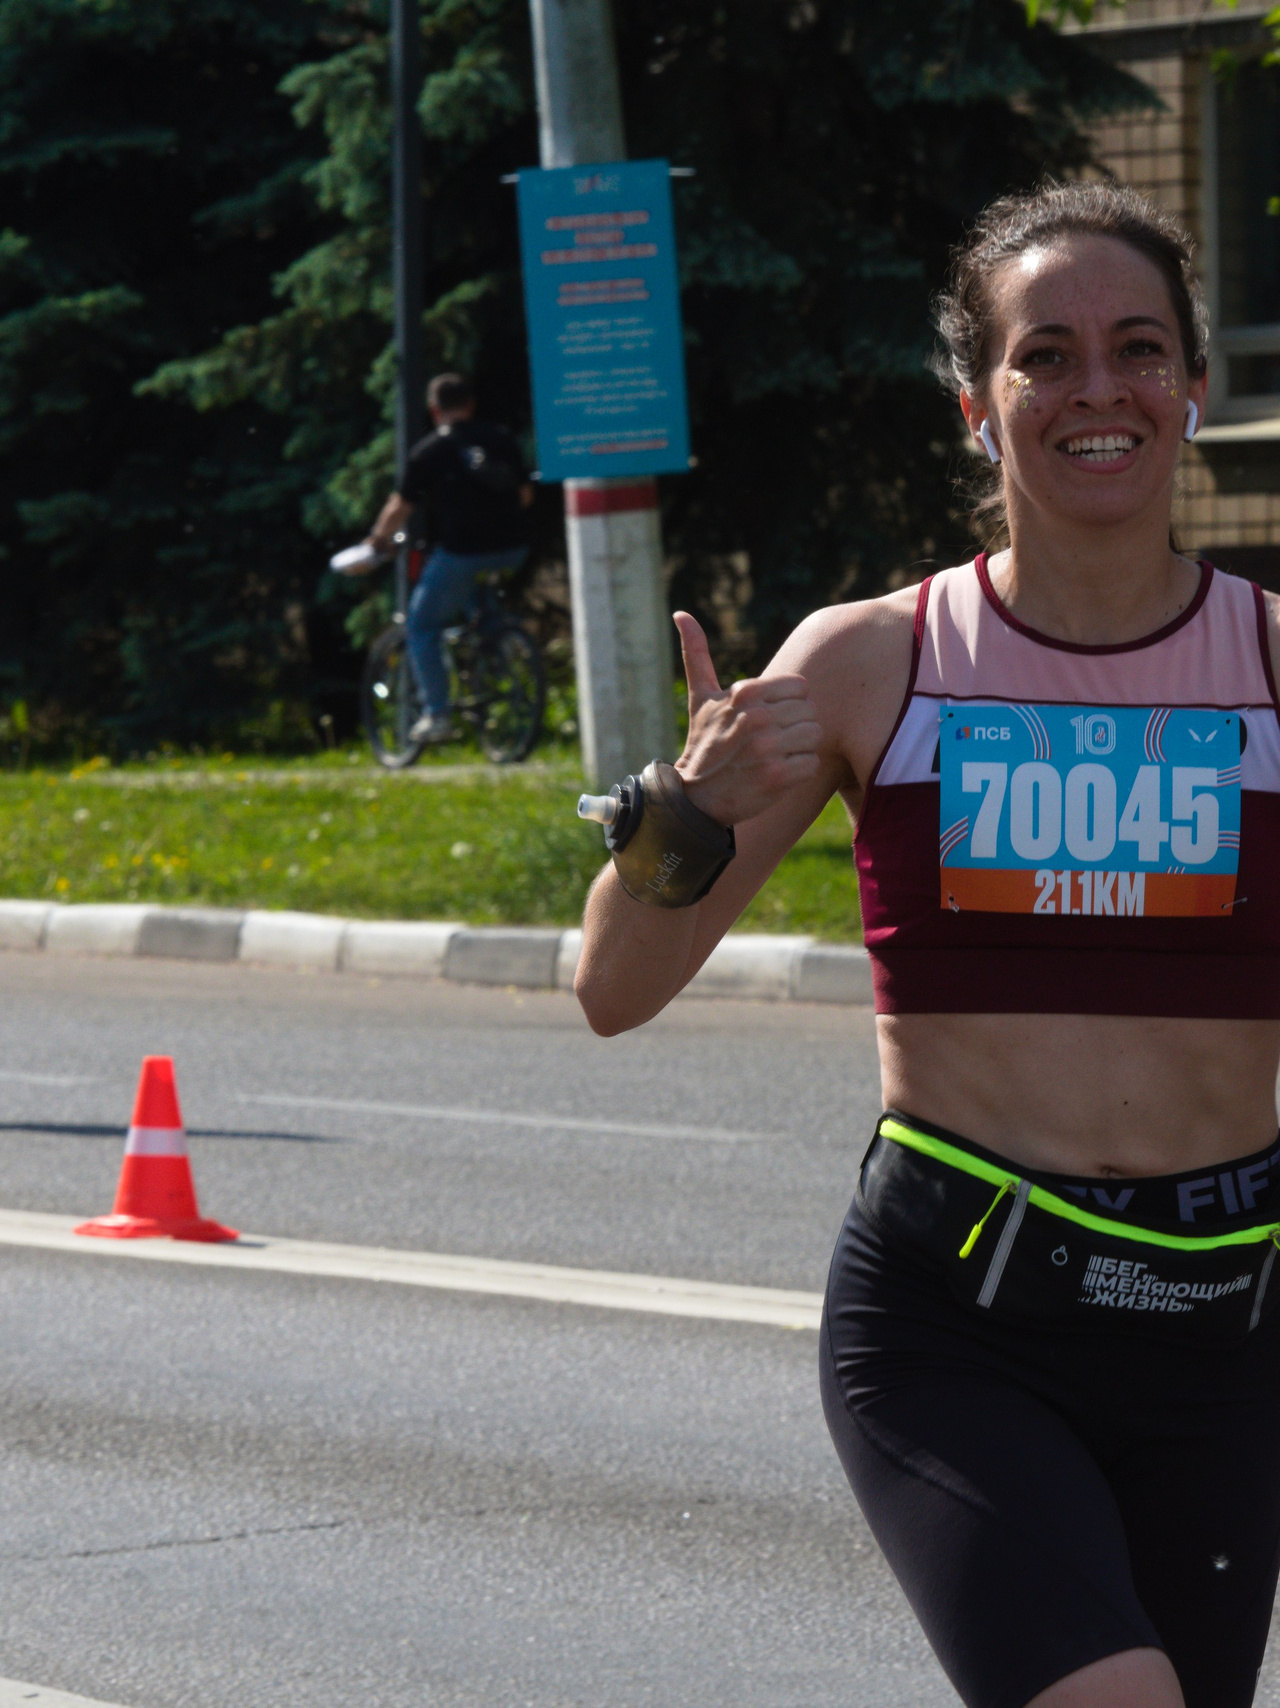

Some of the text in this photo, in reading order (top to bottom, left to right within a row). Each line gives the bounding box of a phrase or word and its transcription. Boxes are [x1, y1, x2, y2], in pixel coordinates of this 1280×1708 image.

[974, 726, 1011, 741] ПСБ
[1069, 713, 1117, 756] 10
[961, 761, 1220, 865] 70045
[645, 851, 683, 894] Luckfit
[1088, 1273, 1252, 1301] МЕНЯЮЩИЙ
[1090, 1290, 1188, 1312] ЖИЗНЬ
